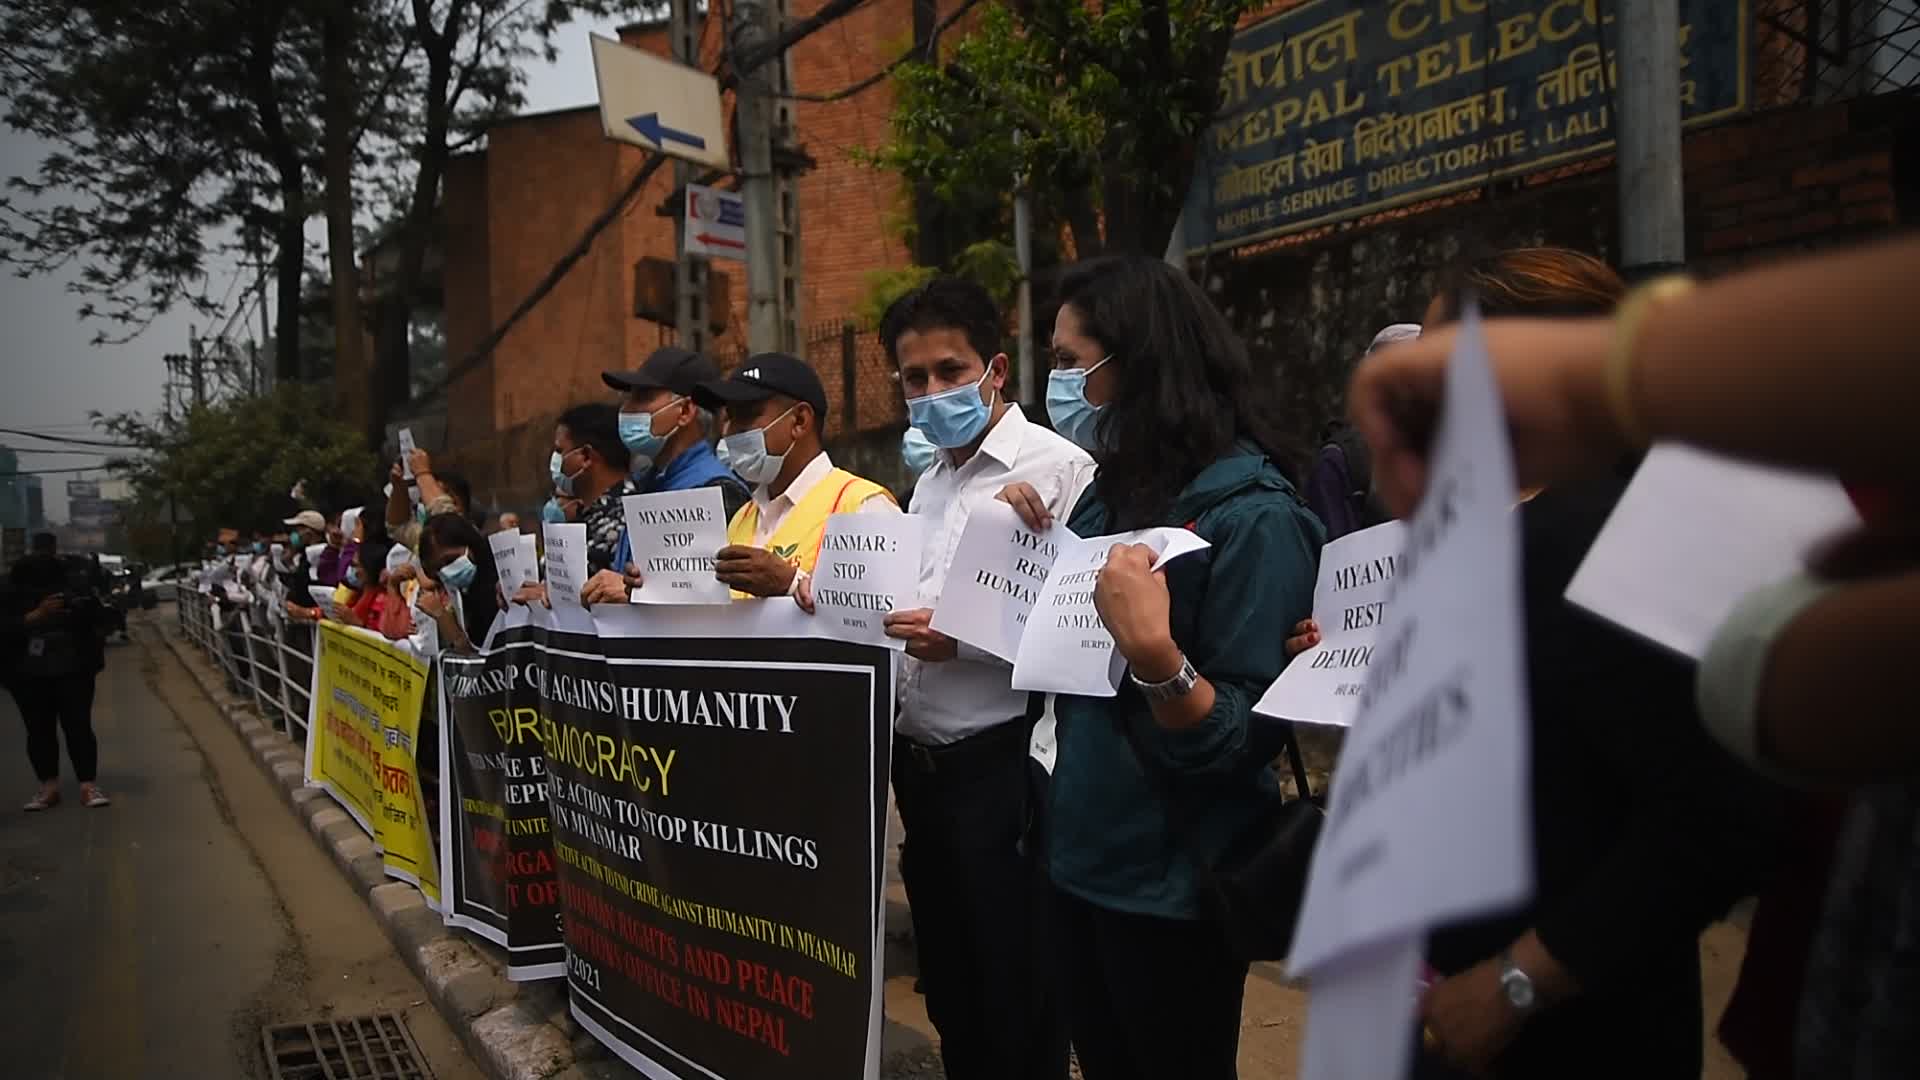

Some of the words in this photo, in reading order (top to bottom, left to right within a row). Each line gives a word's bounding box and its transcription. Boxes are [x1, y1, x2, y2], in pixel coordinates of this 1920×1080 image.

[1217, 79, 1366, 150] NEPAL
[1216, 199, 1277, 232] MOBILE
[1280, 177, 1357, 215] SERVICE
[639, 507, 706, 525] MYANMAR
[663, 532, 694, 548] STOP
[1011, 529, 1058, 561] MYAN
[647, 556, 716, 573] ATROCITIES
[833, 562, 866, 580] STOP
[816, 589, 894, 612] ATROCITIES
[1343, 602, 1386, 631] REST
[1057, 614, 1070, 628] IN
[1072, 614, 1103, 629] MYA
[1081, 639, 1111, 650] HURPES
[620, 686, 798, 733] HUMANITY
[543, 714, 676, 796] EMOCRACY
[567, 780, 612, 819] ACTION
[614, 798, 640, 828] TO
[641, 808, 687, 844] STOP
[692, 819, 819, 870] KILLINGS
[630, 879, 660, 909] CRIME
[660, 893, 704, 926] AGAINST
[706, 904, 777, 946] HUMANITY
[779, 923, 794, 949] IN
[797, 926, 857, 980] MYANMAR
[572, 953, 601, 992] 2021
[683, 943, 732, 985] AND
[736, 958, 815, 1020] PEACE
[687, 980, 710, 1022] IN
[715, 994, 791, 1056] NEPAL
